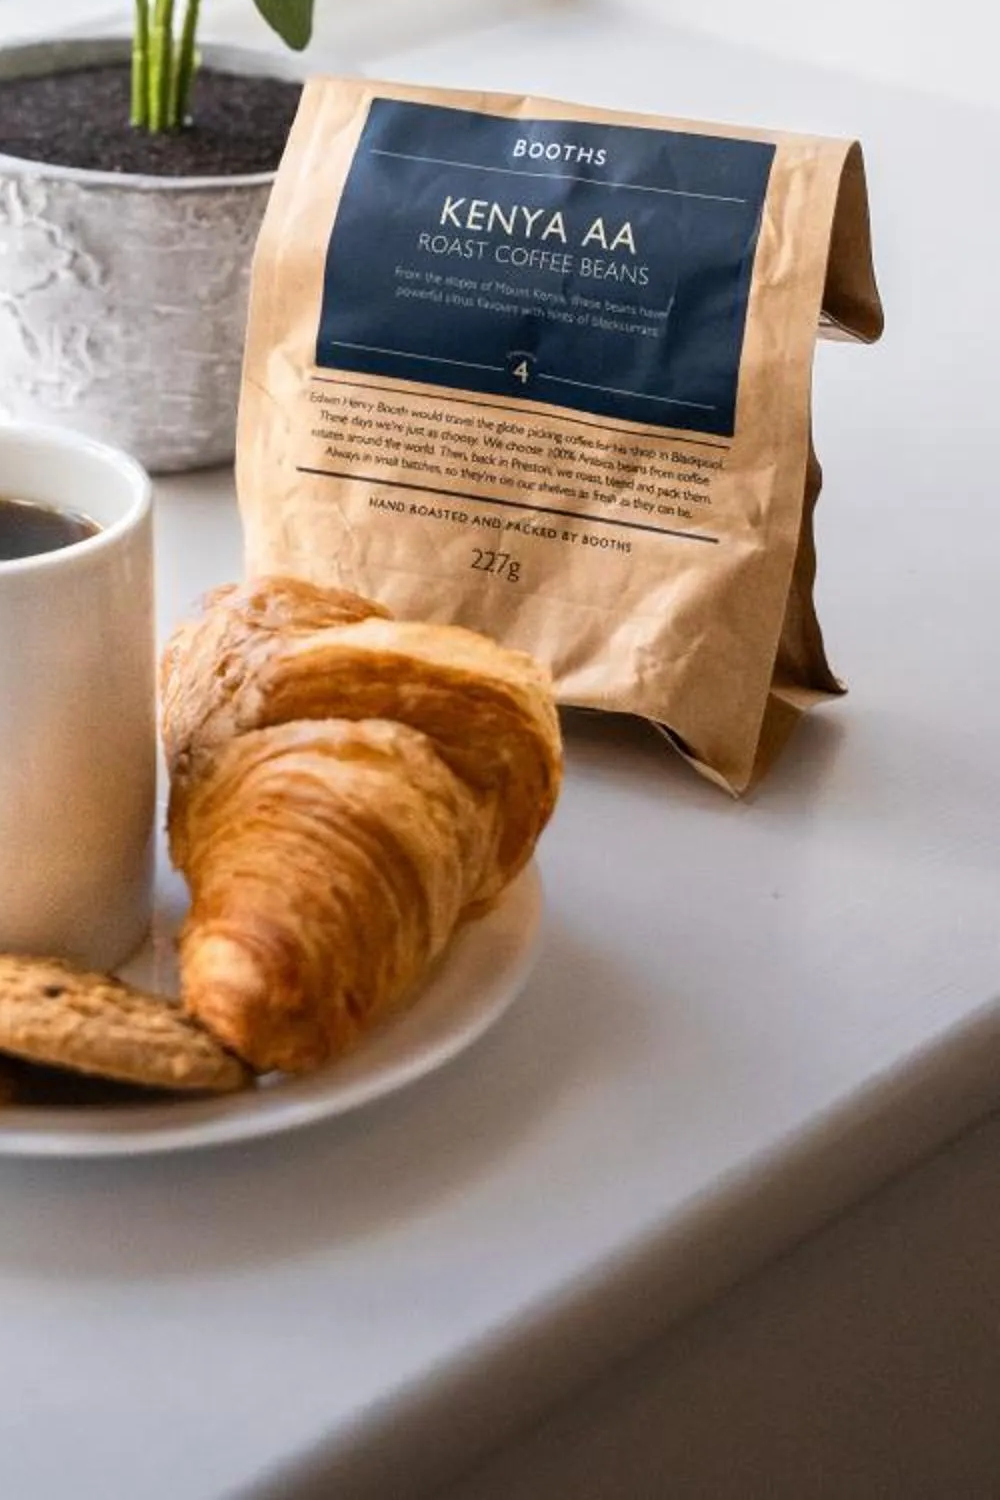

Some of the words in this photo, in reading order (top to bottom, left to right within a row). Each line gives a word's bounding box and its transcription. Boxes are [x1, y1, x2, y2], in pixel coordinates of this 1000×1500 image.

[512, 139, 608, 166] BOOTHS
[439, 195, 568, 244] KENYA
[580, 217, 637, 255] AA
[418, 232, 491, 260] ROAST
[495, 245, 575, 275] COFFEE
[579, 257, 650, 286] BEANS
[495, 282, 529, 297] Mount
[512, 360, 528, 384] 4
[310, 392, 340, 404] Edwin
[411, 409, 443, 422] would
[446, 414, 474, 426] travel
[478, 418, 494, 429] the
[496, 422, 524, 438] globe
[527, 428, 563, 444] picking
[565, 434, 594, 448] coffee
[629, 446, 657, 461] shop
[660, 451, 669, 461] in
[320, 410, 348, 424] These
[352, 416, 372, 429] days
[406, 425, 424, 438] just
[428, 430, 438, 439] as
[483, 435, 503, 448] We
[505, 441, 545, 455] choose
[548, 448, 577, 461] 100%
[578, 451, 615, 470] Arabica
[617, 461, 647, 475] beans
[650, 465, 675, 479] from
[676, 471, 710, 486] coffee
[325, 446, 361, 463] Always
[362, 452, 372, 462] in
[375, 453, 399, 467] small
[444, 466, 458, 477] so
[461, 466, 497, 485] they're
[499, 476, 515, 487] on
[516, 479, 536, 491] our
[538, 482, 577, 498] shelves
[578, 490, 590, 500] as
[593, 488, 617, 504] fresh
[633, 498, 655, 514] they
[657, 504, 675, 516] can
[347, 431, 381, 447] around
[385, 437, 401, 450] the
[471, 452, 496, 466] back
[498, 456, 508, 468] in
[556, 469, 573, 479] we
[605, 475, 635, 490] blend
[636, 480, 654, 494] and
[657, 486, 680, 501] pack
[368, 497, 405, 513] HAND
[409, 504, 469, 524] ROASTED
[471, 514, 501, 530] AND
[503, 519, 557, 540] PACKED
[561, 529, 578, 543] BY
[581, 534, 632, 553] BOOTHS
[471, 548, 521, 583] 227g
